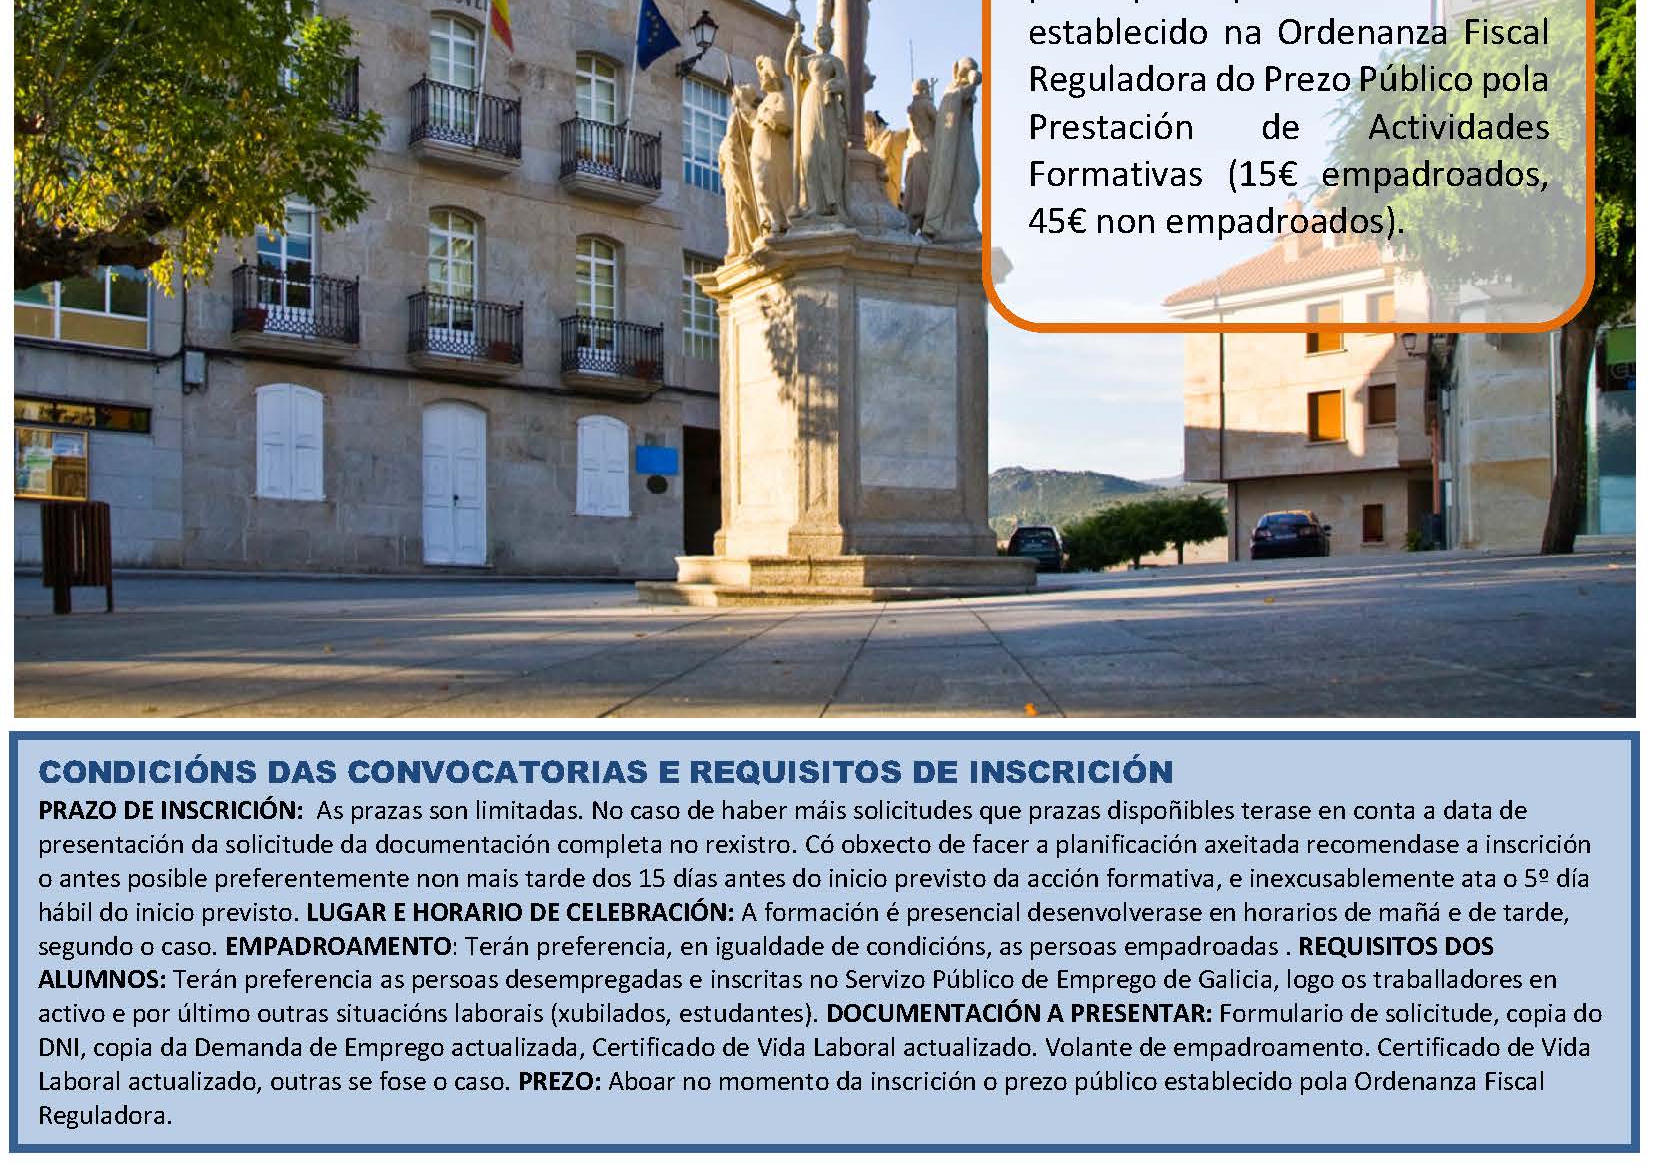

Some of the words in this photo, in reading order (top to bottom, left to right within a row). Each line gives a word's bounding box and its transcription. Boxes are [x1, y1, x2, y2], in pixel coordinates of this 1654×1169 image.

[1030, 17, 1207, 44] establecido
[1226, 26, 1260, 44] na
[1279, 18, 1446, 44] Ordenanza
[1466, 17, 1547, 44] Fiscal
[1031, 64, 1205, 98] Reguladora
[1217, 65, 1254, 91] do
[1266, 66, 1350, 91] Prezo
[1361, 64, 1472, 91] Público
[1484, 64, 1547, 98] pola
[1031, 112, 1192, 139] Prestación
[1263, 113, 1299, 139] de
[1369, 113, 1549, 139] Actividades
[1031, 161, 1202, 186] Formativas
[1230, 159, 1297, 193] (15€
[1323, 160, 1547, 193] empadroados,
[1029, 208, 1086, 233] 45€
[1098, 215, 1154, 233] non
[1167, 206, 1403, 240] empadroados).
[39, 754, 256, 783] CONDICIÓNS
[269, 760, 336, 783] DAS
[348, 760, 647, 783] CONVOCATORIAS
[660, 761, 679, 783] E
[691, 760, 901, 785] REQUISITOS
[914, 761, 957, 783] DE
[971, 754, 1172, 783] INSCRICIÓN
[40, 801, 116, 819] PRAZO
[125, 801, 153, 819] DE
[162, 796, 302, 819] INSCRICIÓN:
[317, 801, 343, 819] As
[352, 806, 422, 824] prazas
[430, 806, 467, 819] son
[477, 800, 582, 819] limitadas.
[593, 801, 623, 819] No
[631, 806, 680, 819] caso
[688, 800, 714, 819] de
[723, 800, 787, 819] haber
[796, 800, 846, 819] máis
[854, 800, 972, 819] solicitudes
[980, 806, 1021, 824] que
[1030, 806, 1100, 824] prazas
[1108, 800, 1234, 824] dispoñibles
[1241, 803, 1311, 819] terase
[1319, 806, 1345, 819] en
[1354, 803, 1414, 819] conta
[1424, 806, 1434, 819] a
[1444, 800, 1491, 819] data
[1500, 800, 1527, 819] de
[40, 902, 91, 921] hábil
[100, 902, 128, 921] do
[137, 903, 194, 921] inicio
[203, 903, 298, 926] previsto.
[308, 903, 386, 921] LUGAR
[395, 903, 405, 921] E
[414, 903, 522, 921] HORARIO
[531, 903, 559, 921] DE
[567, 898, 733, 921] CELEBRACIÓN:
[742, 903, 757, 921] A
[765, 902, 878, 921] formación
[887, 902, 899, 921] é
[908, 902, 1019, 926] presencial
[1028, 902, 1202, 921] desenvolverase
[1210, 908, 1235, 921] en
[1245, 902, 1337, 921] horarios
[1345, 902, 1371, 921] de
[1380, 902, 1439, 921] mañá
[1449, 908, 1461, 921] e
[1469, 902, 1496, 921] de
[1503, 902, 1568, 925] tarde,
[39, 1004, 105, 1022] activo
[113, 1009, 125, 1022] e
[134, 1009, 170, 1027] por
[179, 1003, 250, 1022] último
[258, 1006, 328, 1022] outras
[337, 1003, 447, 1022] situacións
[456, 1003, 543, 1022] laborais
[552, 1003, 670, 1027] (xubilados,
[680, 1003, 817, 1027] estudantes).
[828, 999, 1040, 1022] DOCUMENTACIÓN
[1047, 1004, 1064, 1022] A
[1072, 1004, 1211, 1022] PRESENTAR:
[1221, 1003, 1343, 1022] Formulario
[1351, 1003, 1378, 1022] de
[1386, 1003, 1498, 1026] solicitude,
[1507, 1004, 1565, 1027] copia
[1574, 1003, 1602, 1022] do
[40, 1105, 171, 1129] Reguladora.
